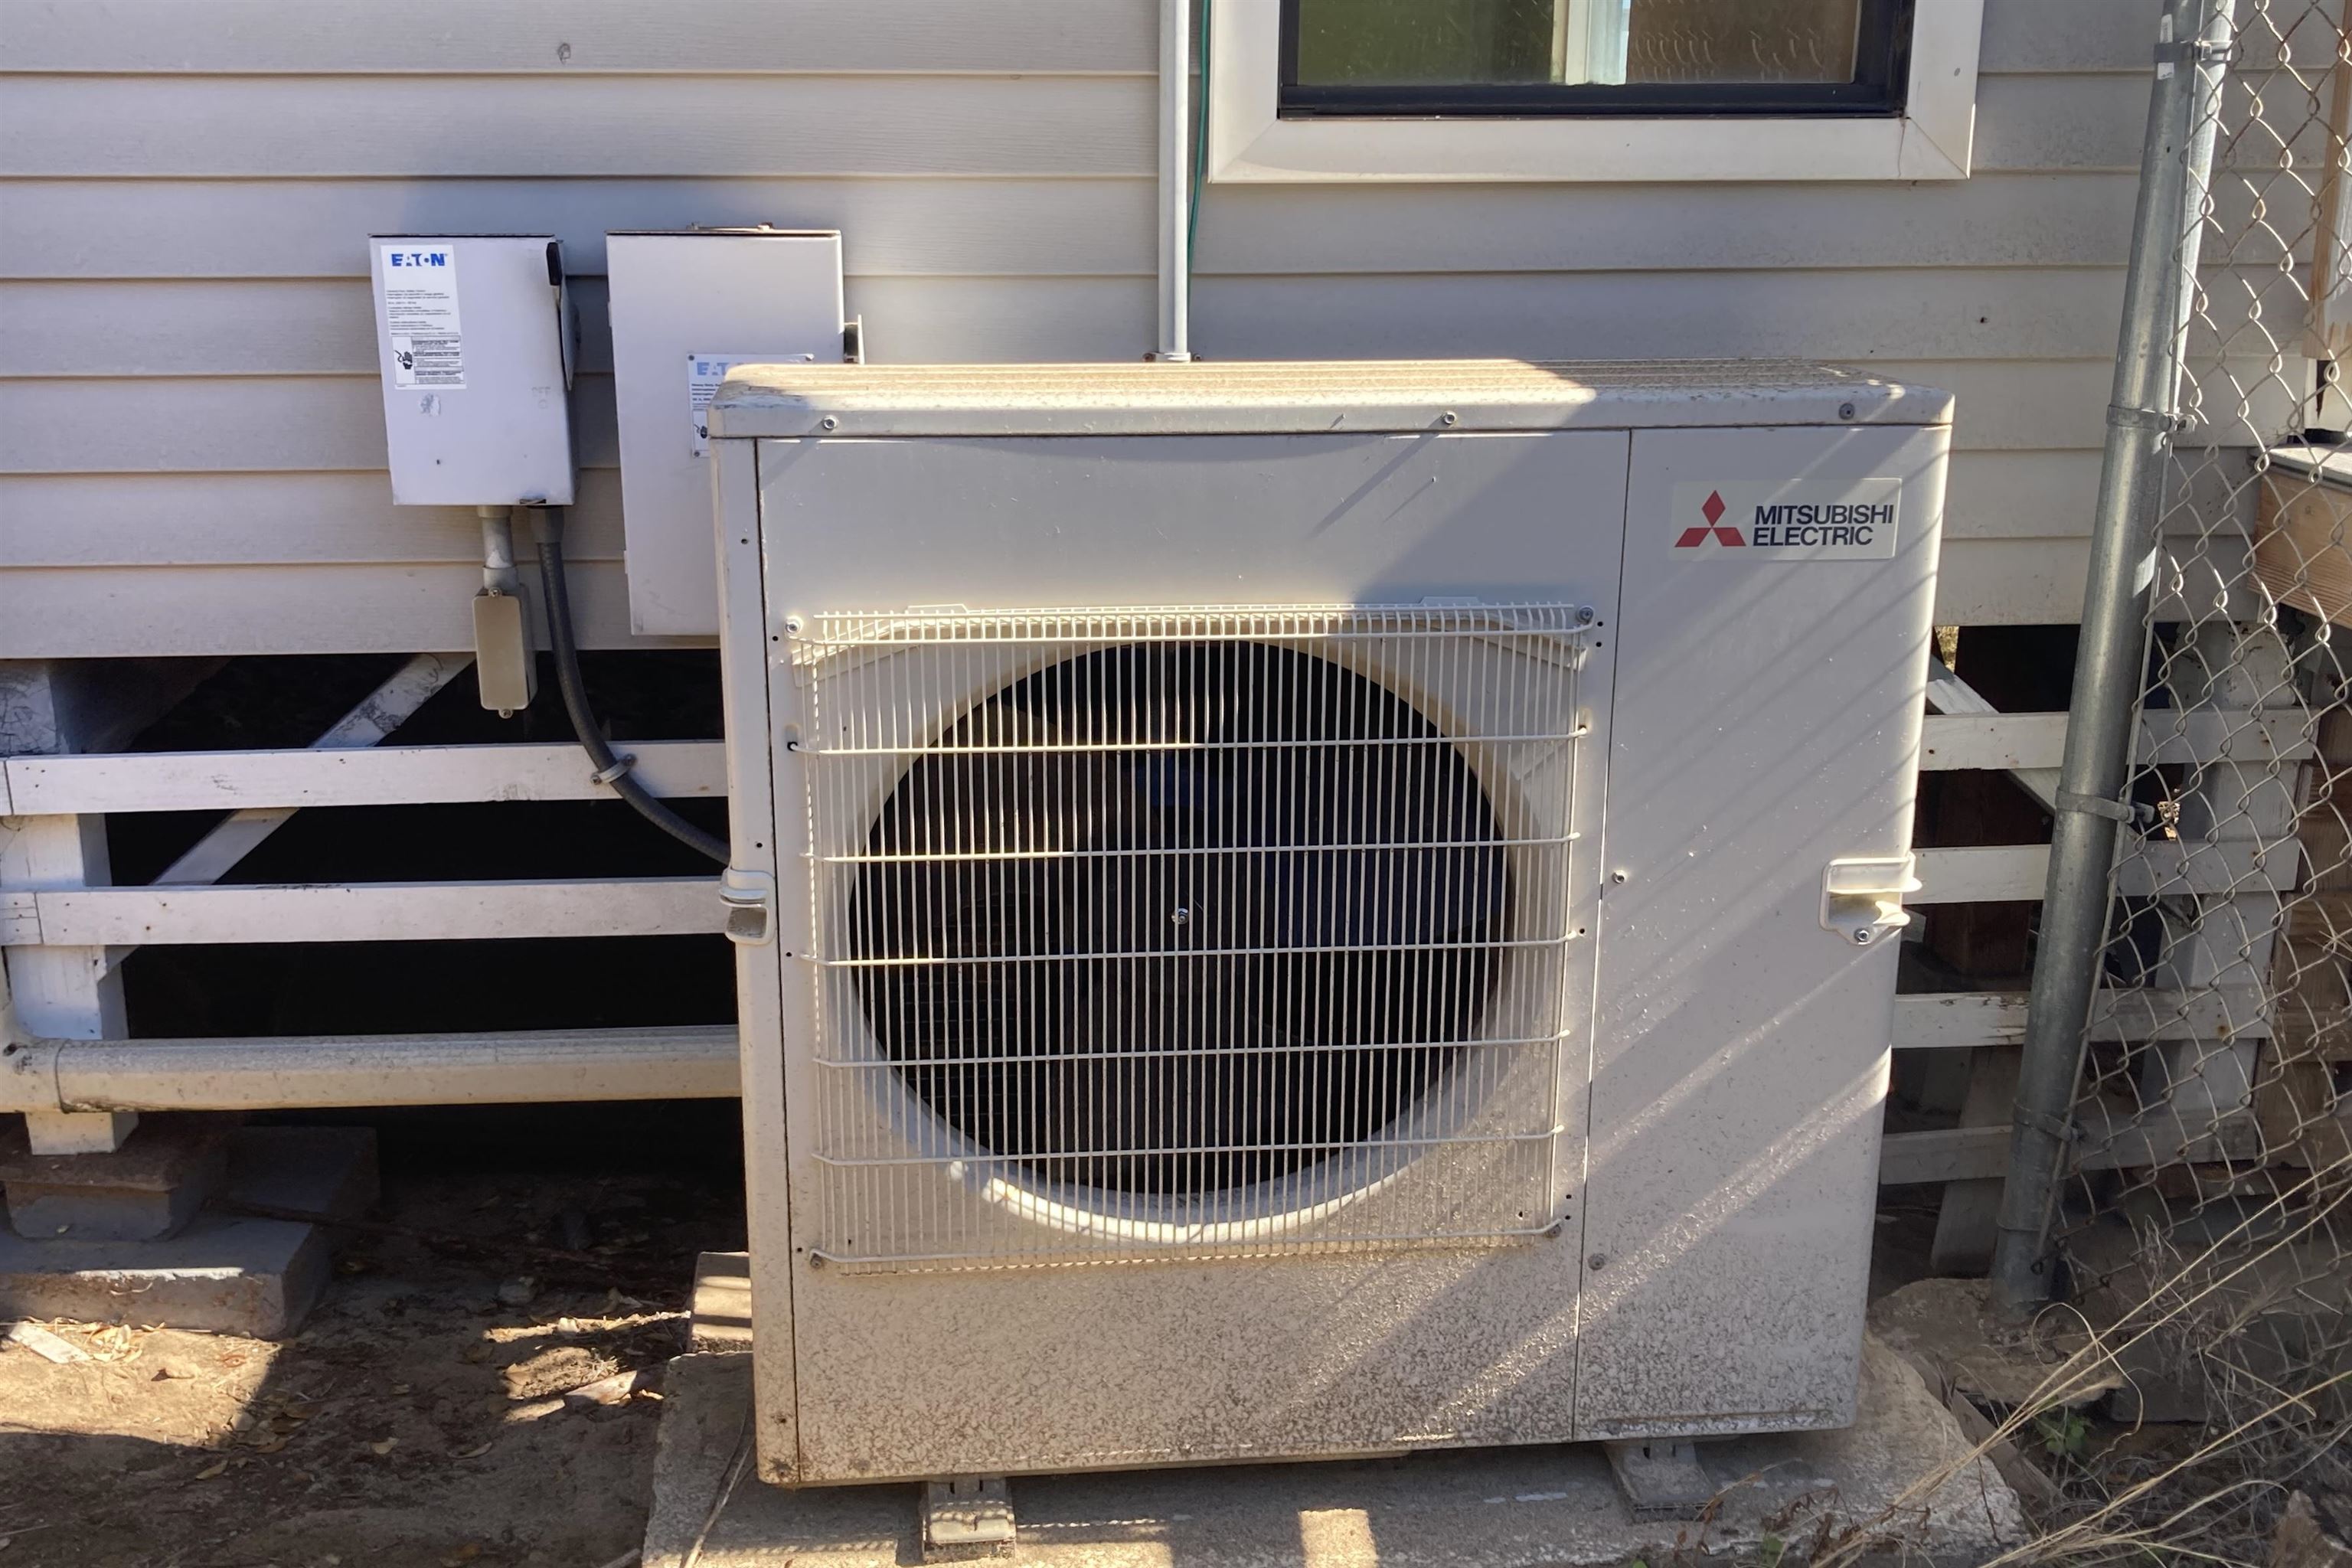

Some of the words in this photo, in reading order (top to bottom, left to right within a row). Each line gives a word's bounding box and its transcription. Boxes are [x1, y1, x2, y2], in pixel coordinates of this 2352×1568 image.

[391, 253, 446, 266] EATON
[1755, 505, 1893, 524] MITSUBISHI
[1753, 526, 1873, 546] ELECTRIC
